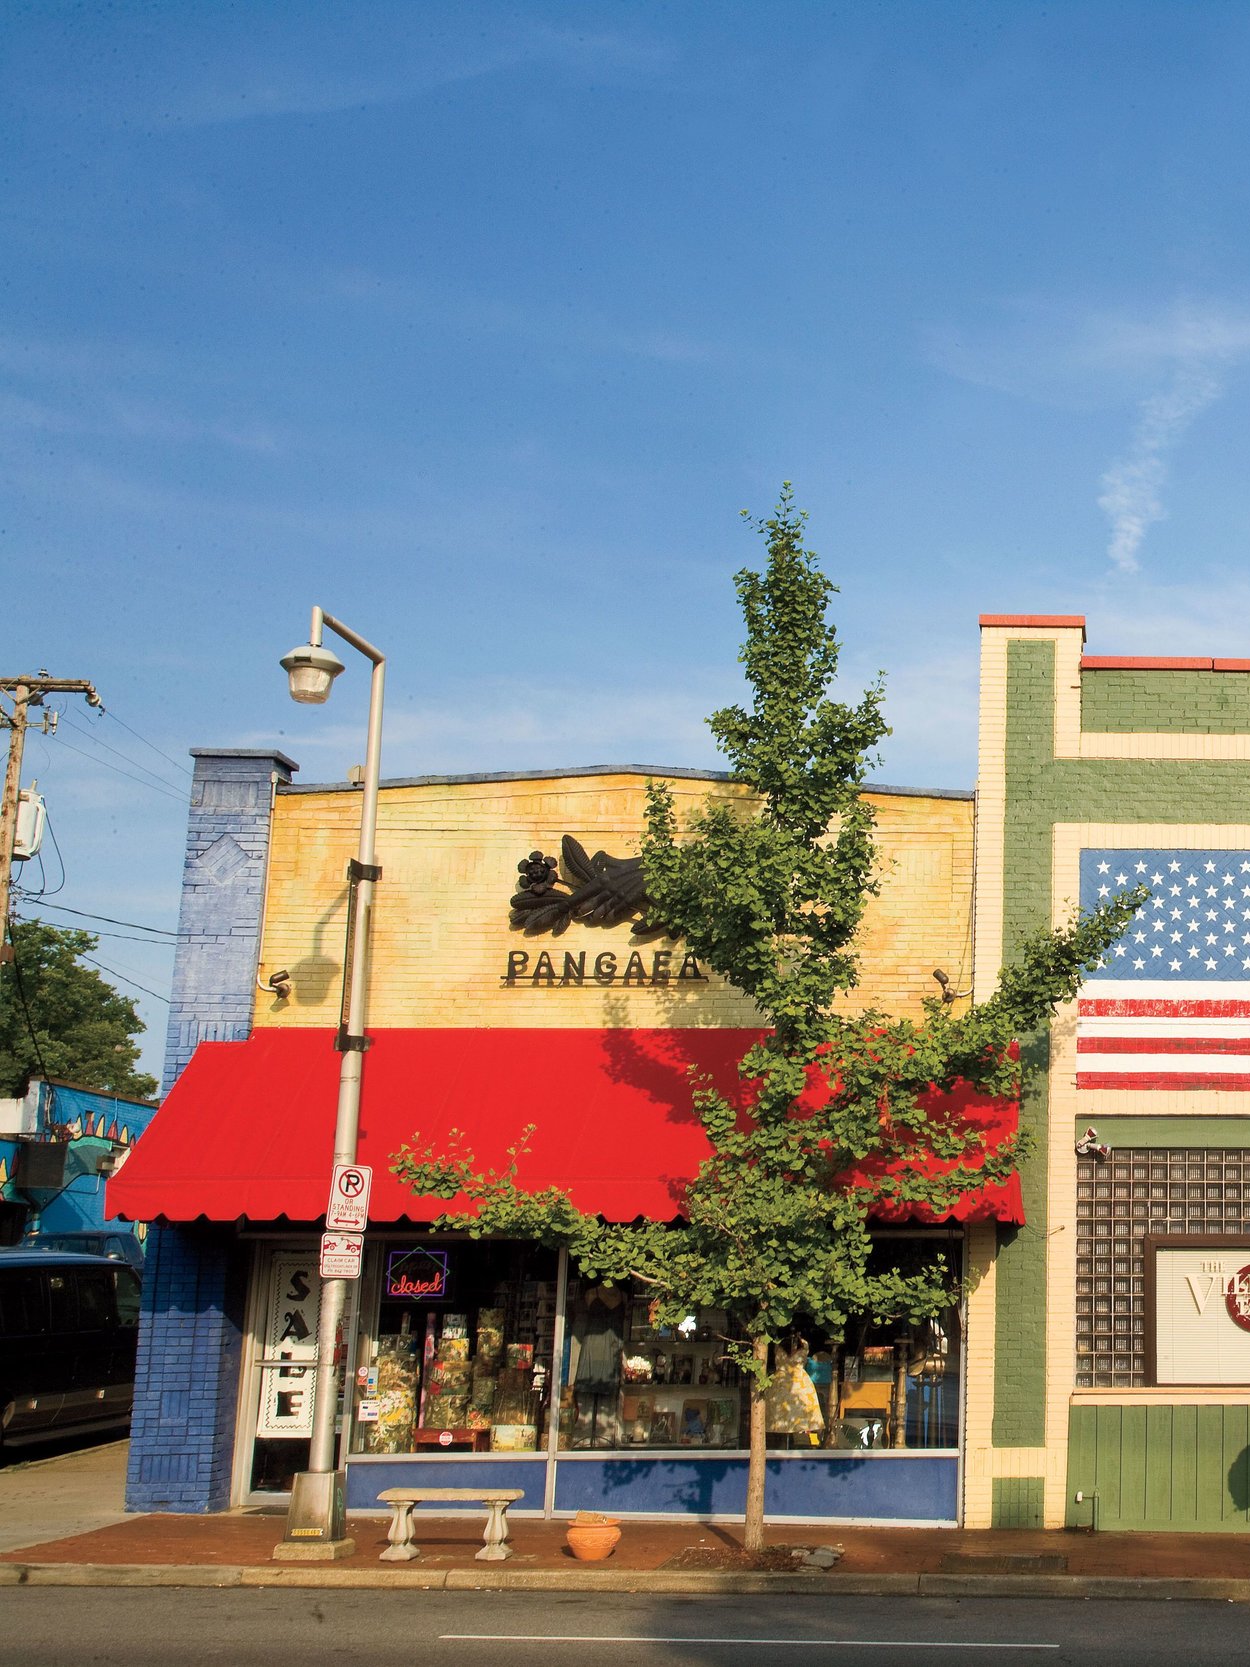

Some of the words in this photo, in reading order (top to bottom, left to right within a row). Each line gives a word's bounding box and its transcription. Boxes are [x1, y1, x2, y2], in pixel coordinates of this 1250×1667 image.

[508, 951, 702, 979] PANGAEA
[332, 1203, 365, 1213] STANDING
[1200, 1261, 1226, 1273] THE
[391, 1272, 442, 1295] closed
[275, 1269, 312, 1418] SALE
